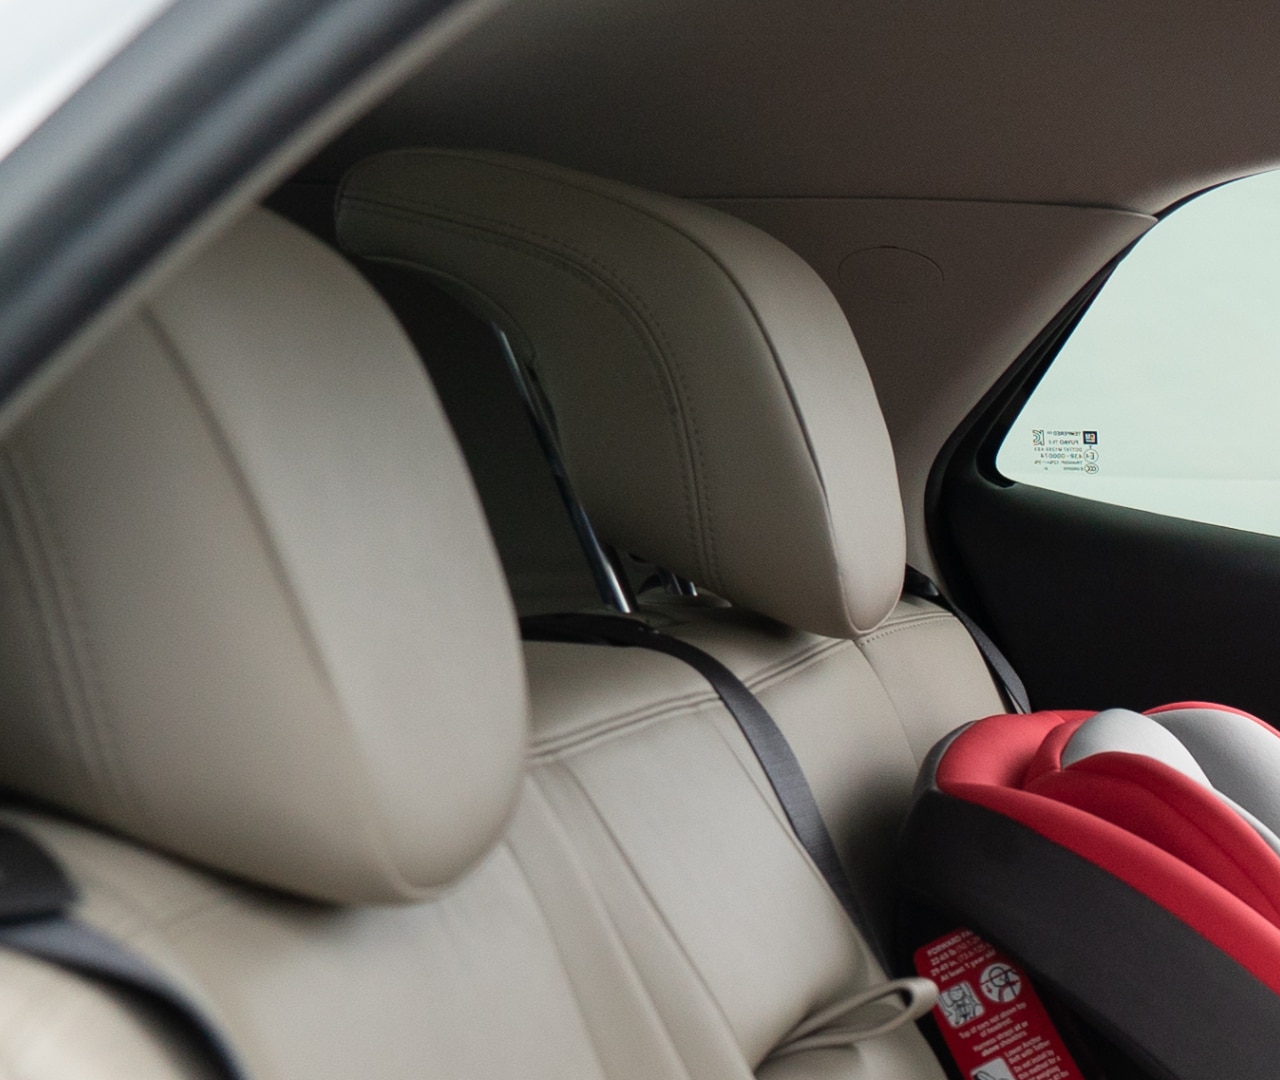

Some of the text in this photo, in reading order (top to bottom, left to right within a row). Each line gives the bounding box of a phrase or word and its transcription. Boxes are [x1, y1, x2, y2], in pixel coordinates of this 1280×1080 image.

[927, 936, 961, 956] FORWARD
[949, 967, 965, 976] least
[970, 957, 984, 968] year
[959, 1031, 970, 1039] Top
[990, 1015, 999, 1023] not
[1000, 1008, 1016, 1018] above
[973, 1038, 996, 1051] Harness
[996, 1029, 1014, 1040] straps
[982, 1045, 999, 1056] above
[1005, 1036, 1040, 1057] Lower Anchor
[1008, 1040, 1049, 1064] Belt with Tether
